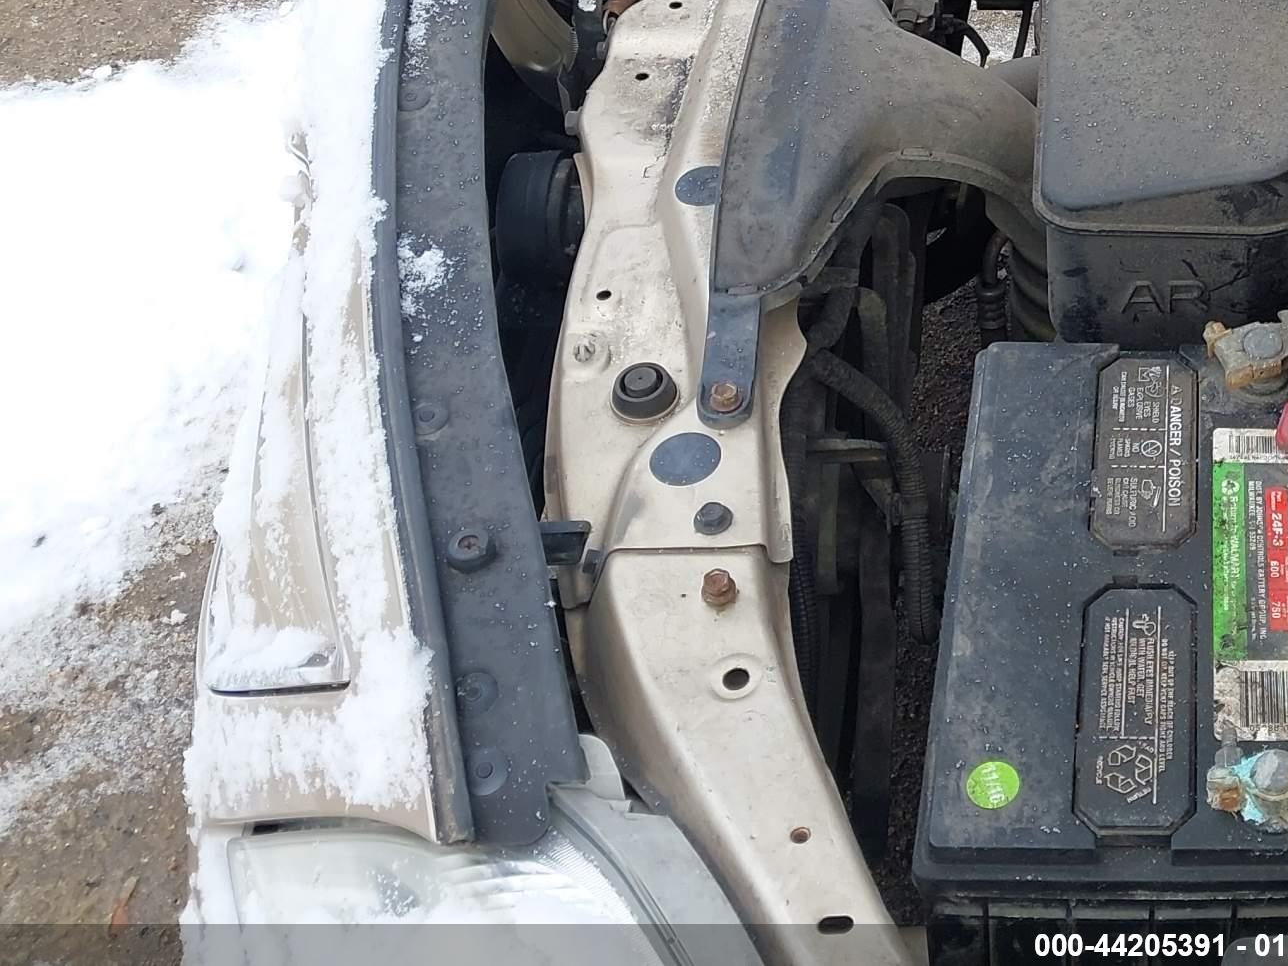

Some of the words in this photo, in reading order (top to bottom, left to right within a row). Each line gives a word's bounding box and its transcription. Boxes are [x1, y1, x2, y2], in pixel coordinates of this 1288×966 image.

[1121, 280, 1208, 314] AR
[1169, 397, 1182, 446] DANGER
[1168, 459, 1182, 506] POISON
[1271, 601, 1281, 619] 750
